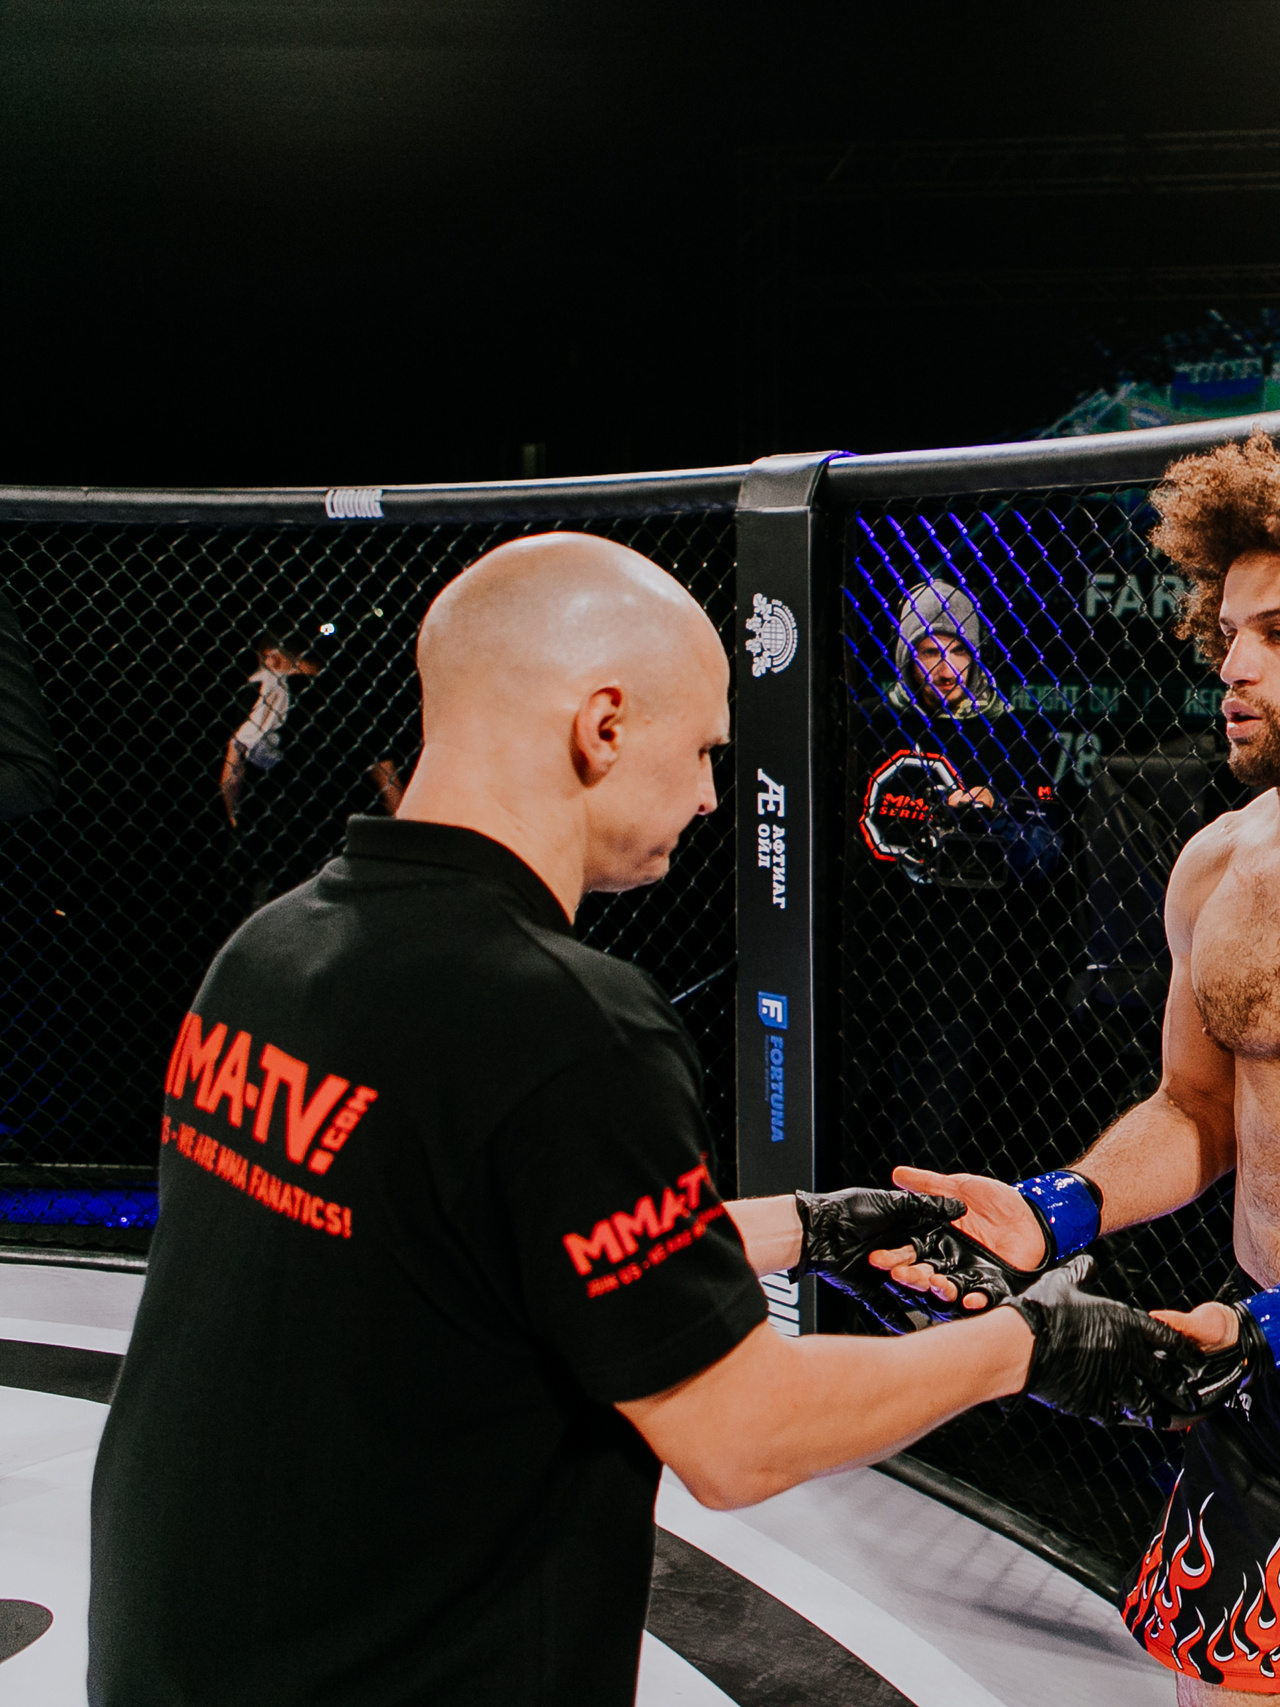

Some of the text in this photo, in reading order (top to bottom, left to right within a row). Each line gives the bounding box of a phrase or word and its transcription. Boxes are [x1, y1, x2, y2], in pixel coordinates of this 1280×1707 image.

[758, 823, 772, 868] ОЙЛ
[772, 824, 786, 909] АФТИАГ
[770, 1035, 785, 1143] FORTUNA
[248, 1164, 352, 1239] FANATICS!
